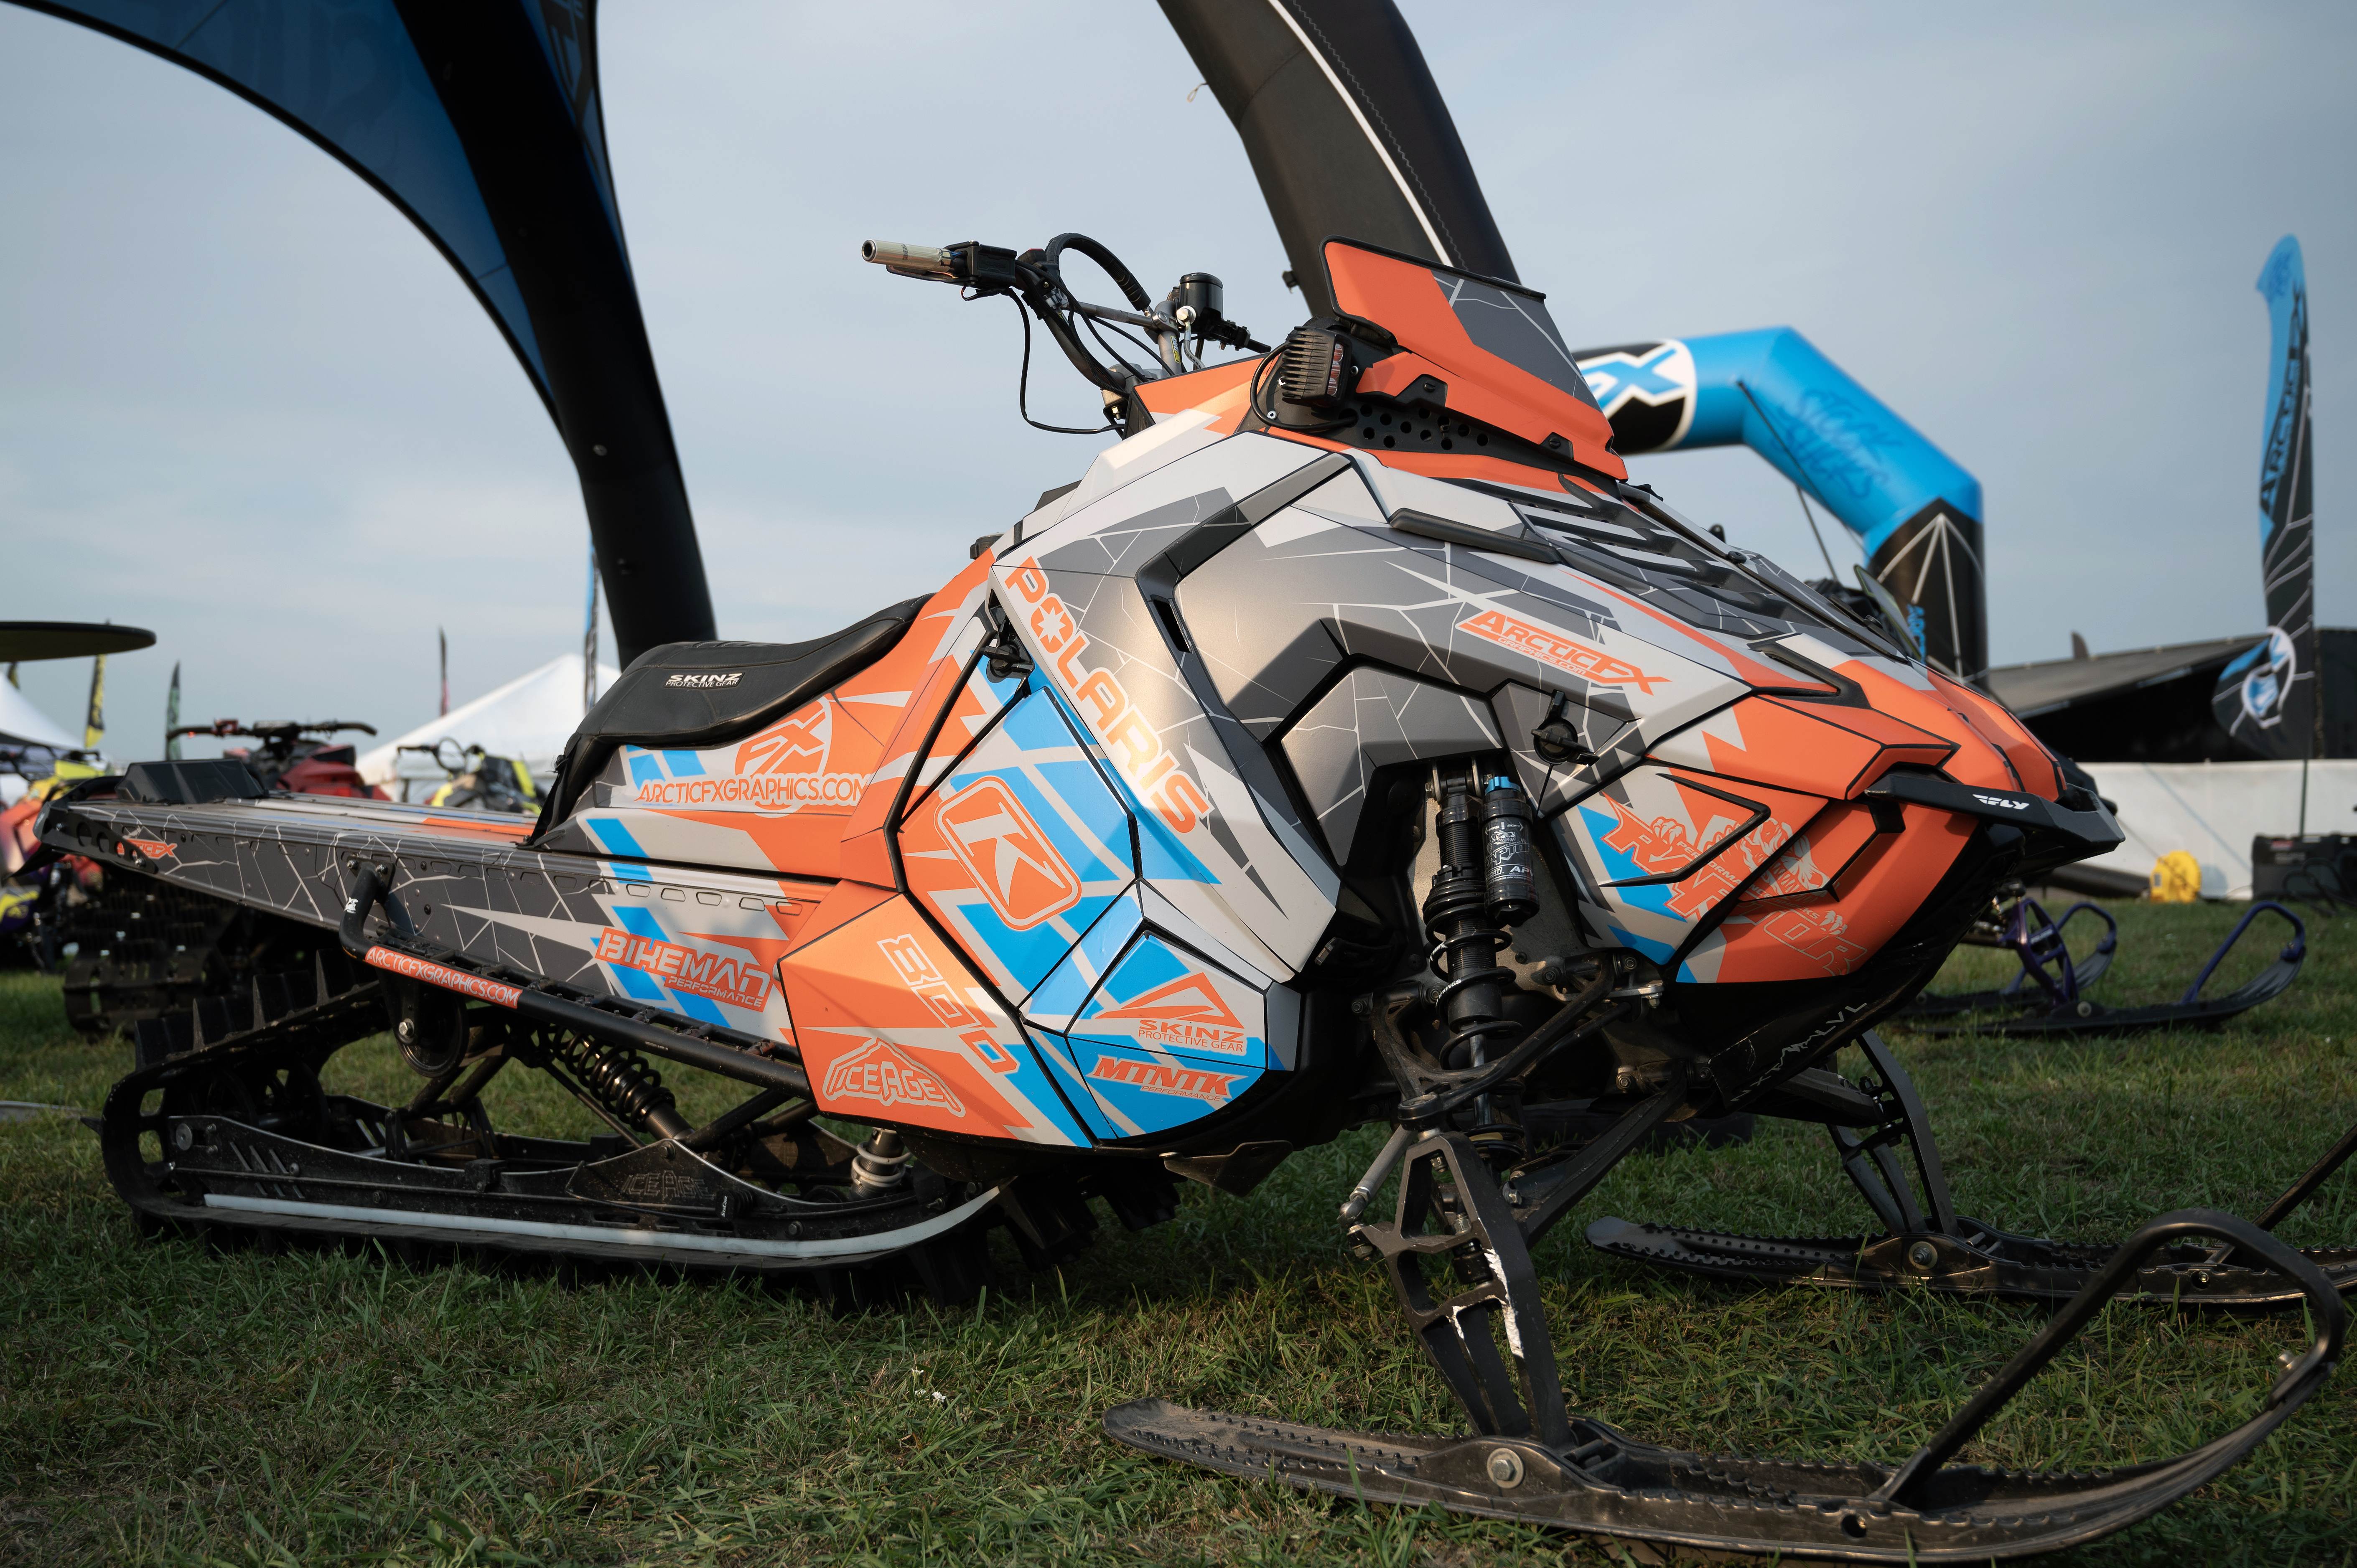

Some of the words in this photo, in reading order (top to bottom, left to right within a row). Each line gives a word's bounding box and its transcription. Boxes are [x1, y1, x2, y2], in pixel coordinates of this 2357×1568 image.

[1458, 610, 1672, 696] ARCTICFX
[1497, 638, 1586, 675] GRAPHICS.COM
[668, 673, 743, 682] SKINZ
[1005, 556, 1209, 833] POLARIS
[735, 712, 826, 776] FX
[1978, 794, 2029, 810] FLY
[946, 802, 1066, 906] K
[1774, 898, 1820, 920] SHOCKS
[367, 947, 521, 1007] ARCTICFXGRAPHICS.COM
[599, 933, 771, 999] BIKEMAN
[668, 976, 763, 1007] PERFORMANCE
[877, 934, 1020, 1074] 800
[1138, 1029, 1207, 1047] PROTECTIVE
[1211, 1040, 1243, 1052] GEAR
[1139, 1019, 1244, 1044] SKINZ
[835, 1061, 944, 1099] ICEAGE
[1092, 1057, 1236, 1095] MTNTK
[1141, 1085, 1222, 1101] PERFORMANCE
[621, 1169, 715, 1201] ICEAGE
